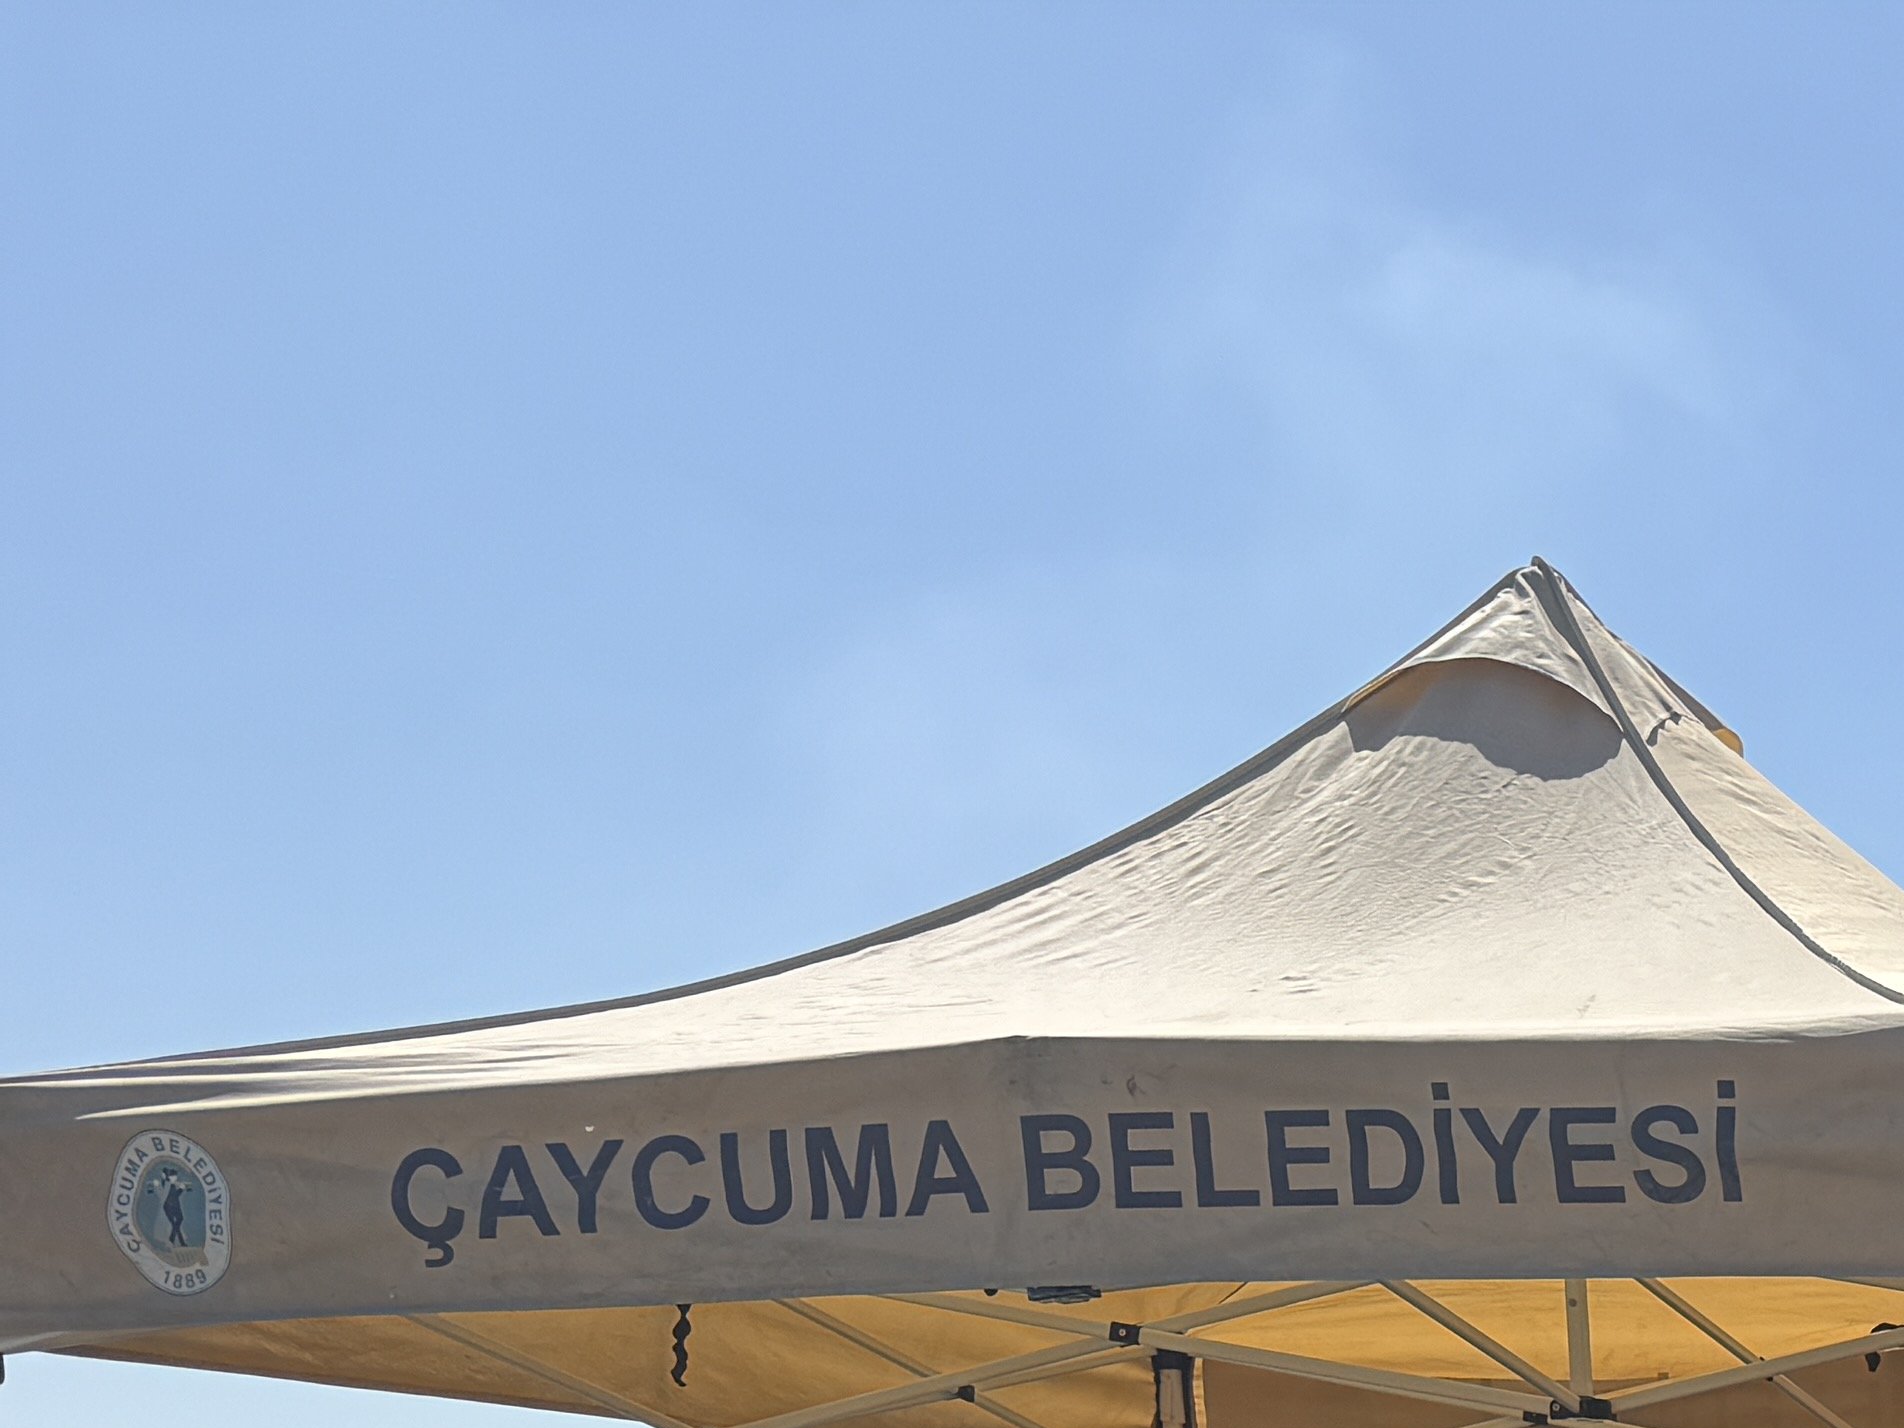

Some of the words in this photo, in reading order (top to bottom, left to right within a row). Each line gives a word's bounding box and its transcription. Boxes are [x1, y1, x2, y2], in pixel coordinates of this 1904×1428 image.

[115, 1146, 149, 1254] ÇAYCUMA
[390, 1119, 990, 1268] ÇAYCUMA
[1019, 1079, 1744, 1212] BELEDİYESİ
[163, 1268, 207, 1290] 1889
